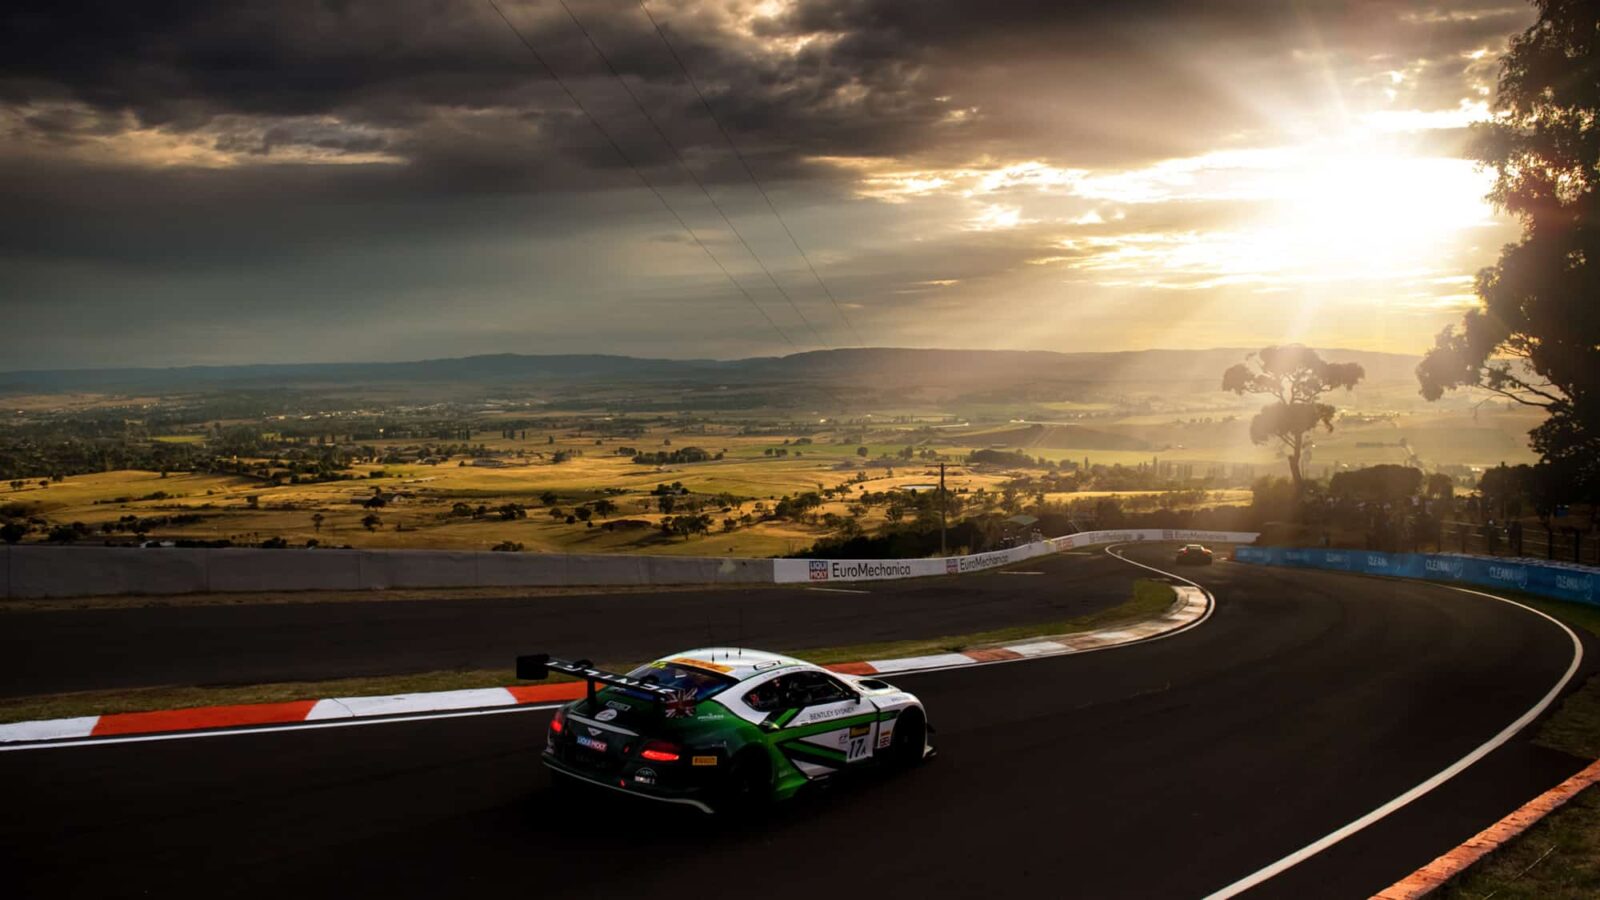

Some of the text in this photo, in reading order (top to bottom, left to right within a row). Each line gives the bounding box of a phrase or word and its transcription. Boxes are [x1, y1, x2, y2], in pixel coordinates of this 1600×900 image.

[809, 561, 828, 570] LIQUI
[832, 562, 911, 578] EuroMechanica
[809, 570, 828, 579] MOLY
[809, 706, 855, 721] BENTLEY SYDNEY
